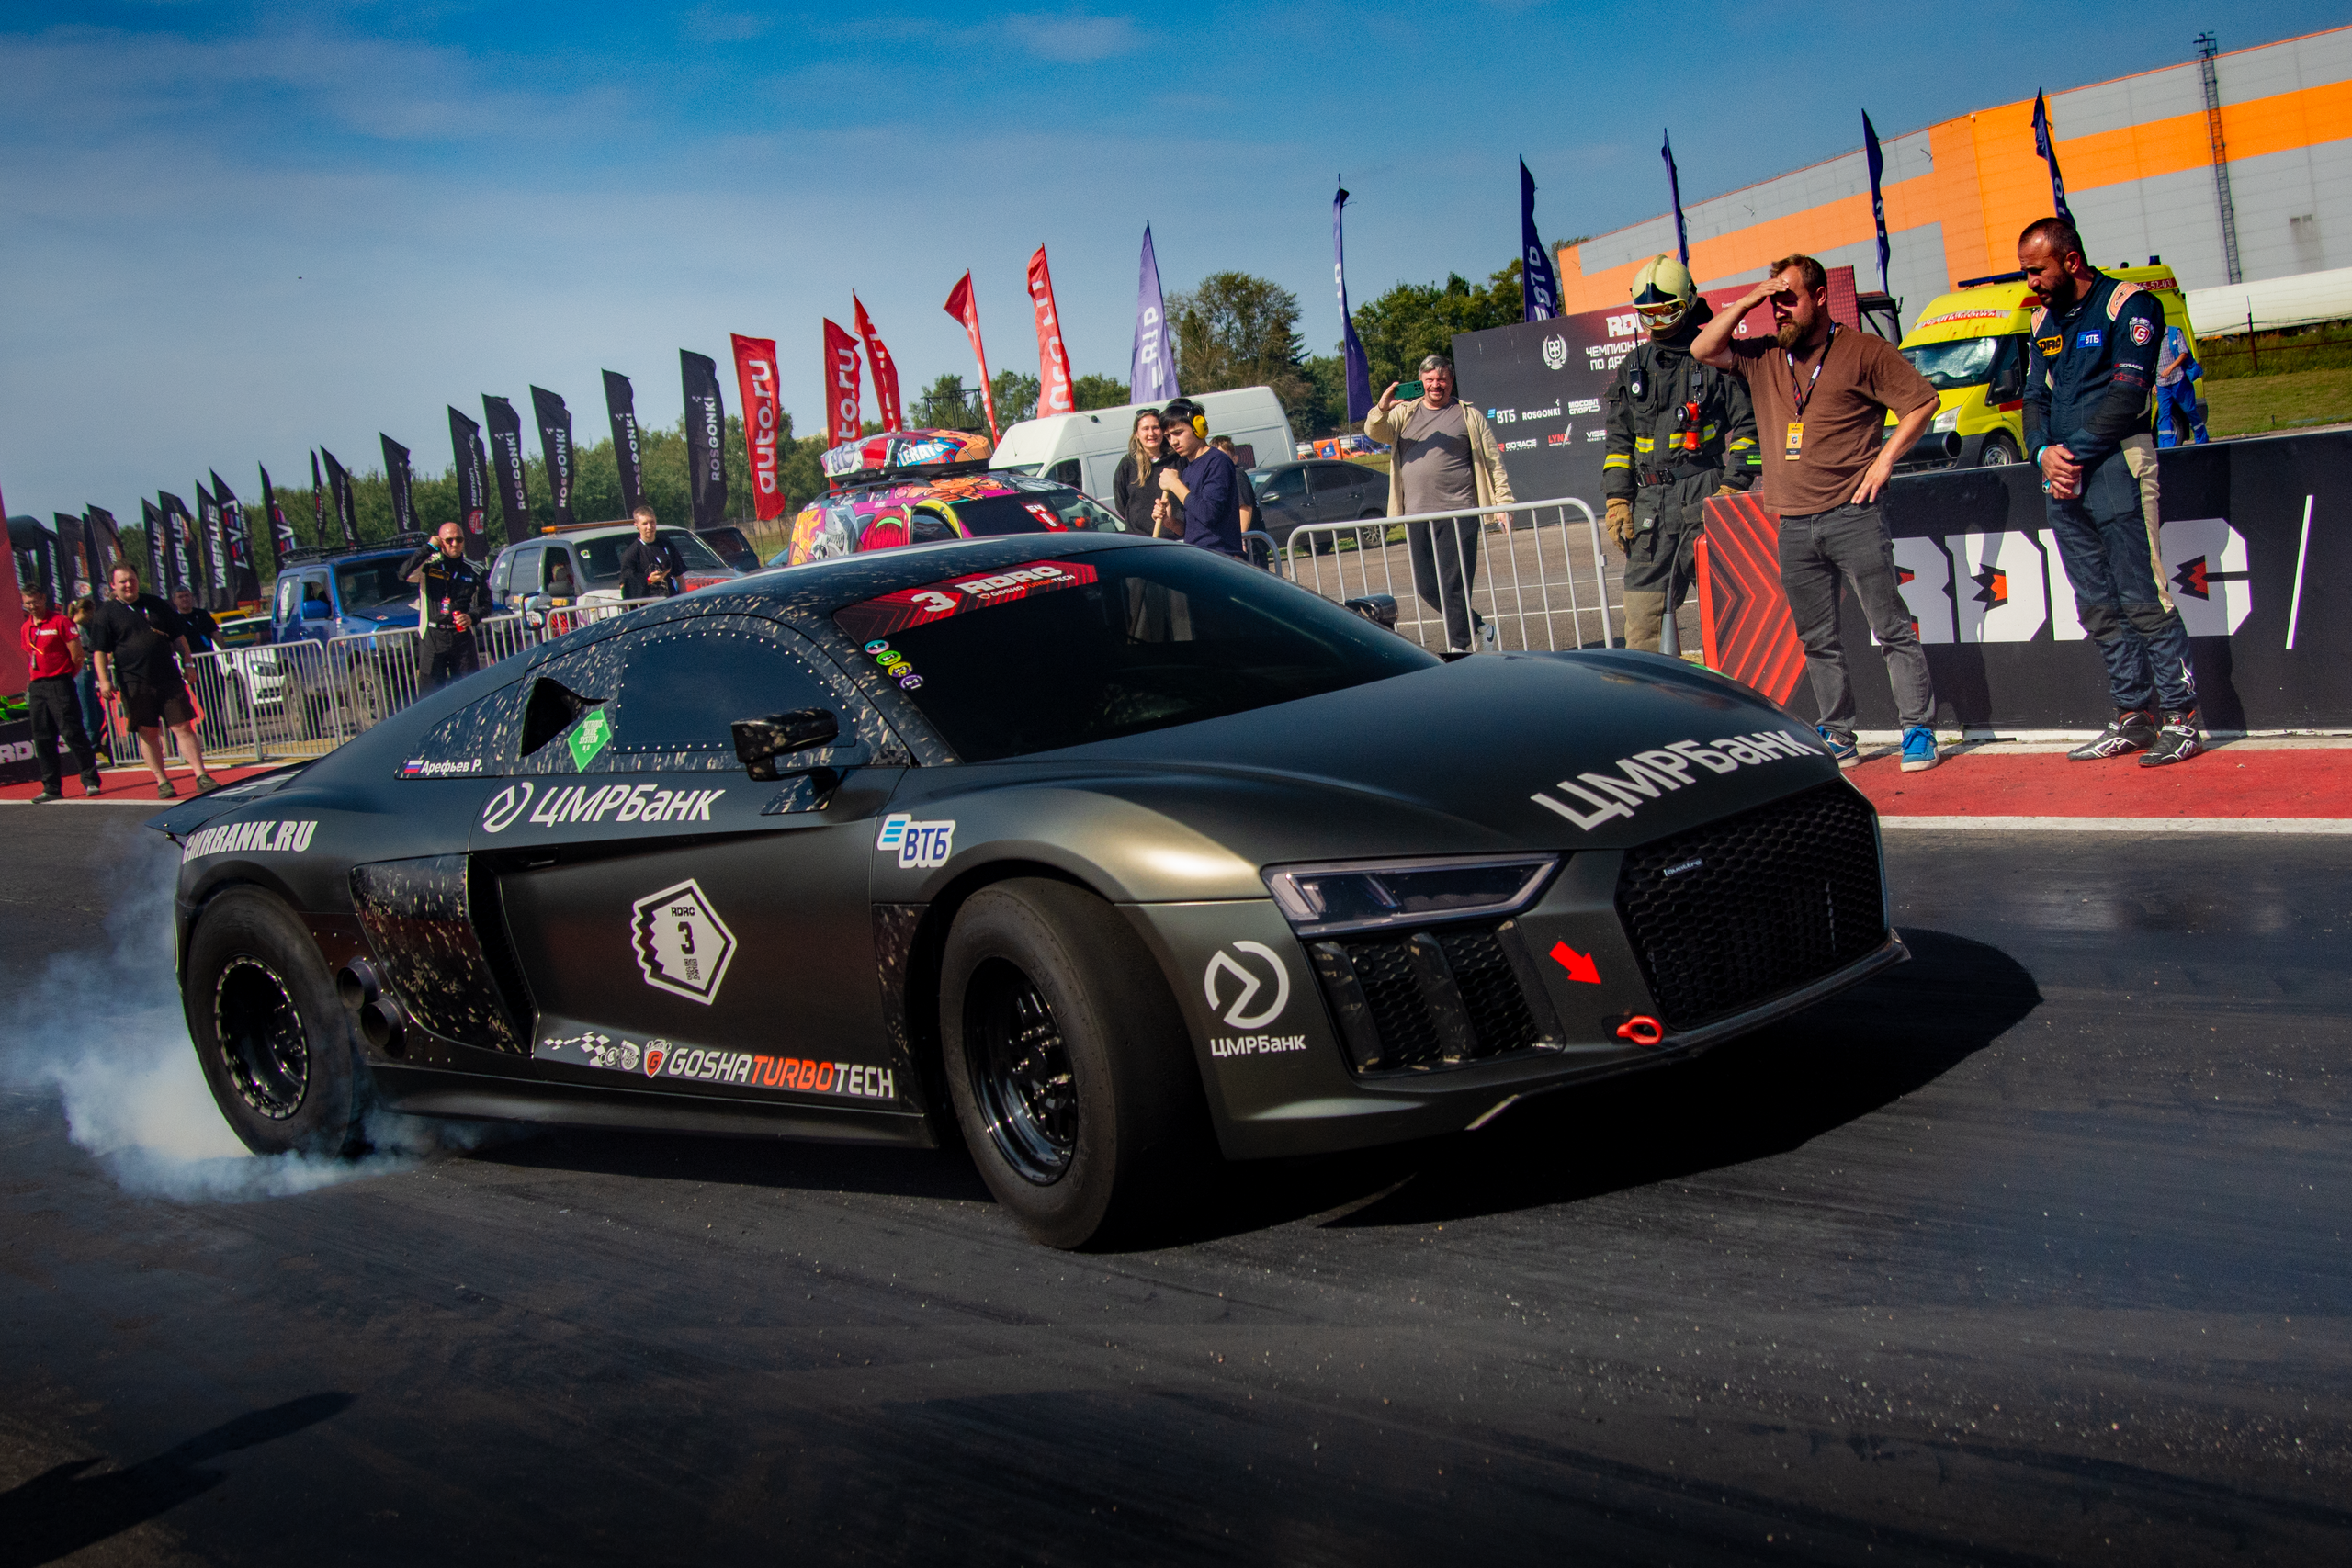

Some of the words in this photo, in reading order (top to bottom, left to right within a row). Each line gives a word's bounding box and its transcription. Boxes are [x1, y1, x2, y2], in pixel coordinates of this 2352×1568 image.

[1605, 313, 1645, 338] RD
[2086, 334, 2099, 344] ВТБ
[1590, 357, 1605, 371] ПО
[1607, 355, 1626, 370] ДР
[751, 359, 777, 495] auto.ru
[1497, 409, 1517, 424] ВТБ
[1521, 408, 1561, 421] ROSGONKI
[705, 396, 722, 482] ROSGONKI
[504, 432, 526, 510] ROSGONKI
[556, 428, 569, 508] ROSGONKI
[152, 520, 168, 600] VAGPLUS
[207, 504, 227, 590] VAGPLUS
[955, 566, 1062, 594] RDRC
[911, 592, 957, 612] 3
[420, 760, 470, 776] Арефьев
[1530, 729, 1826, 831] ЦМРБанк
[529, 783, 726, 828] ЦМРБанк
[182, 821, 318, 864] CMRBANK.RU
[902, 827, 950, 862] ВТБ
[1668, 859, 1702, 874] quattro
[671, 906, 695, 918] RDRC
[677, 921, 695, 955] 3
[1209, 1033, 1306, 1058] ЦМРБанк
